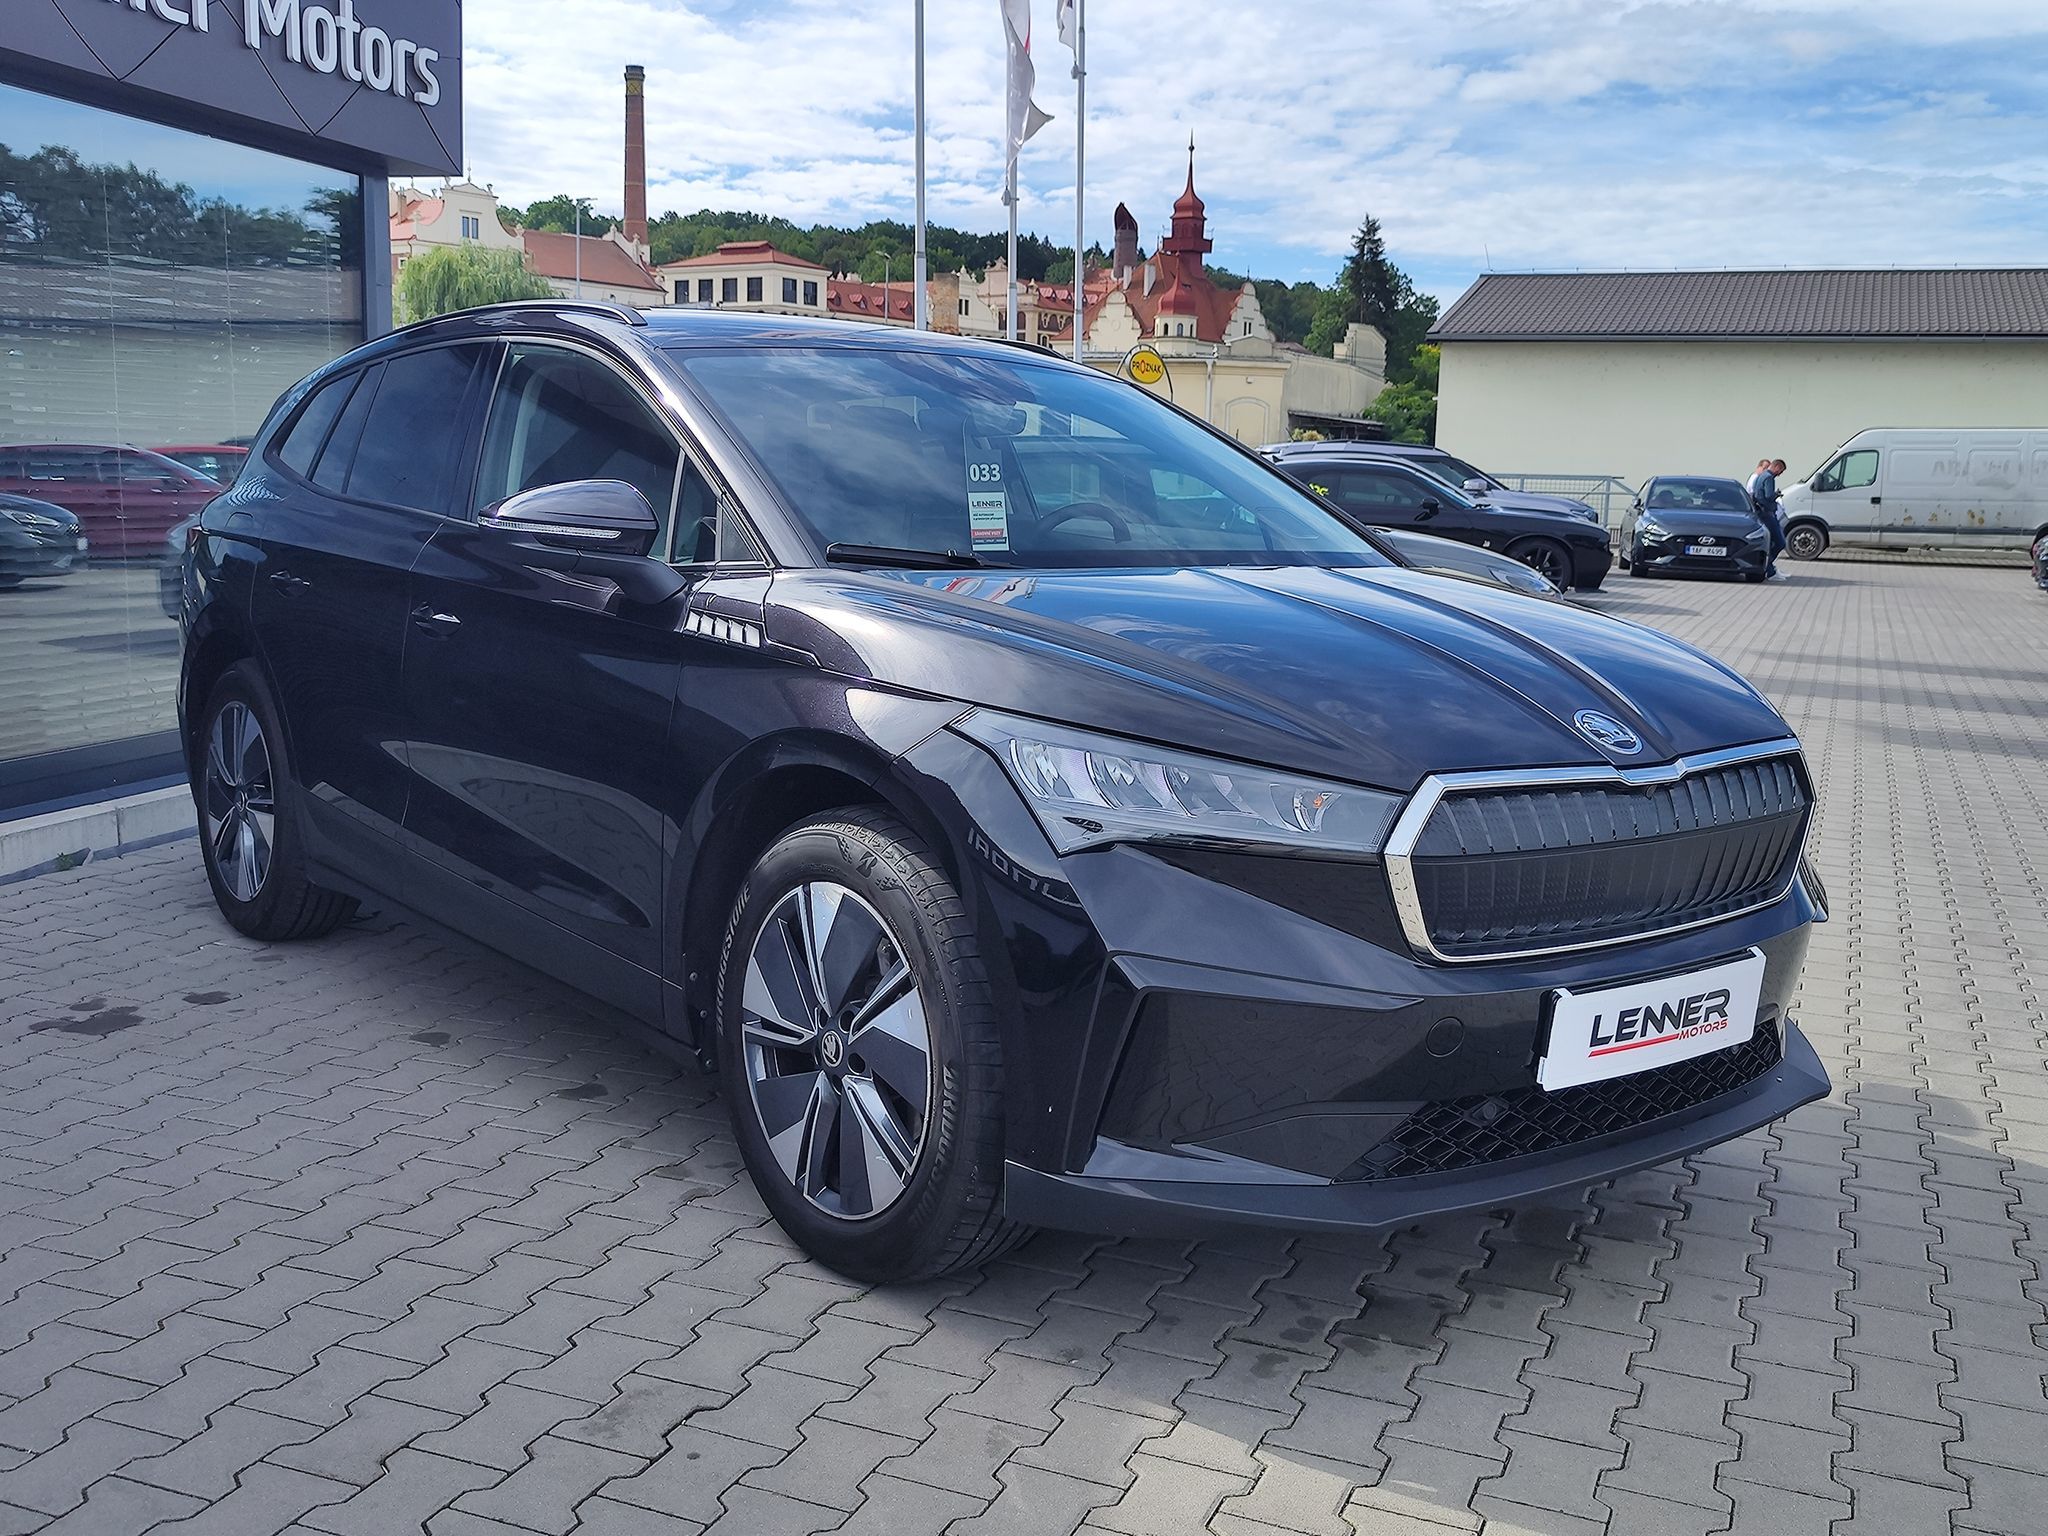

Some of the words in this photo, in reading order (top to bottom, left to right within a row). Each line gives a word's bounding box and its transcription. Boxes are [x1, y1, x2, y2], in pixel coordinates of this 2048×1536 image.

[243, 0, 440, 106] Motors
[969, 463, 1001, 482] 033
[1589, 988, 1731, 1048] LENNER
[1679, 1018, 1729, 1041] MOTORS
